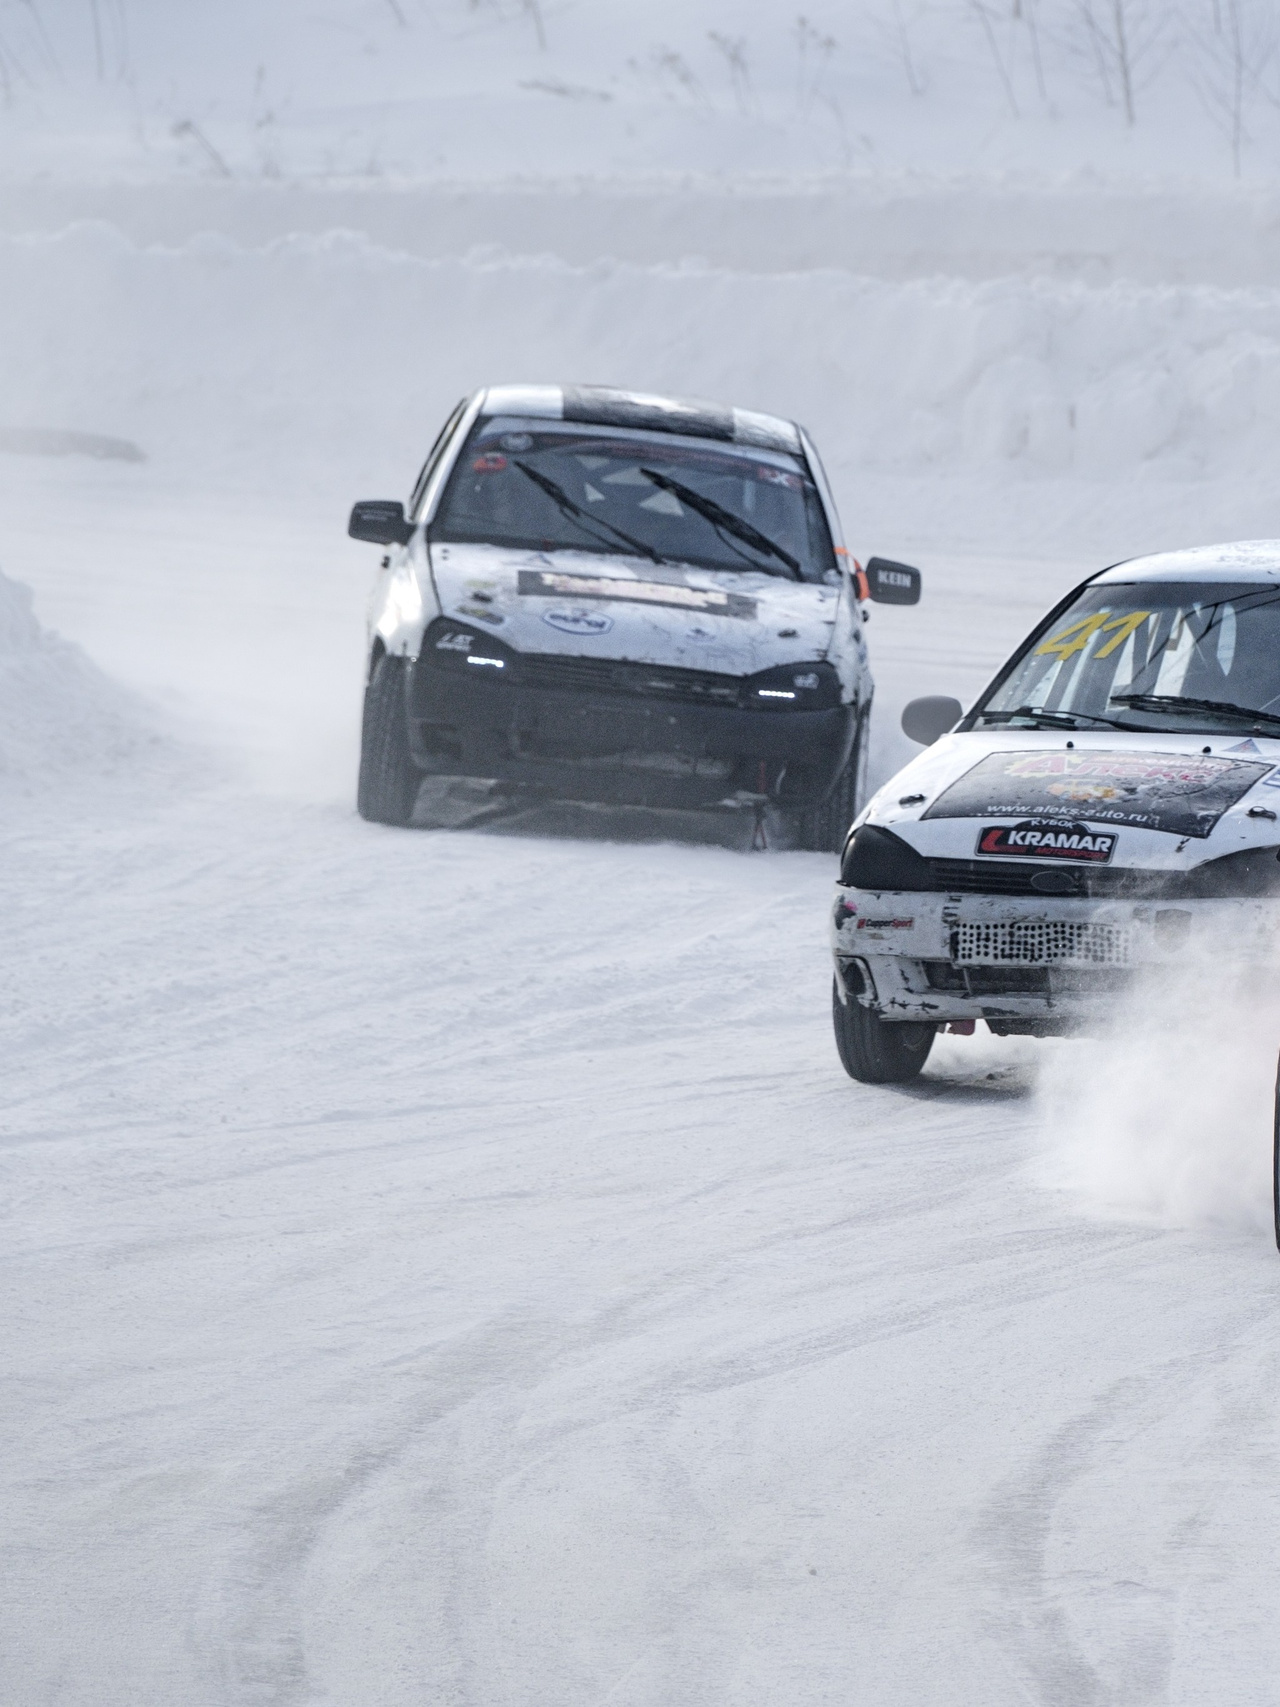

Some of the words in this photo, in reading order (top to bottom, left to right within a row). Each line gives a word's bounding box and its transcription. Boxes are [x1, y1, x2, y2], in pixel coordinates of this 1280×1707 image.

[877, 569, 912, 588] KEIN
[1033, 610, 1152, 661] 41
[1007, 830, 1113, 853] KRAMAR
